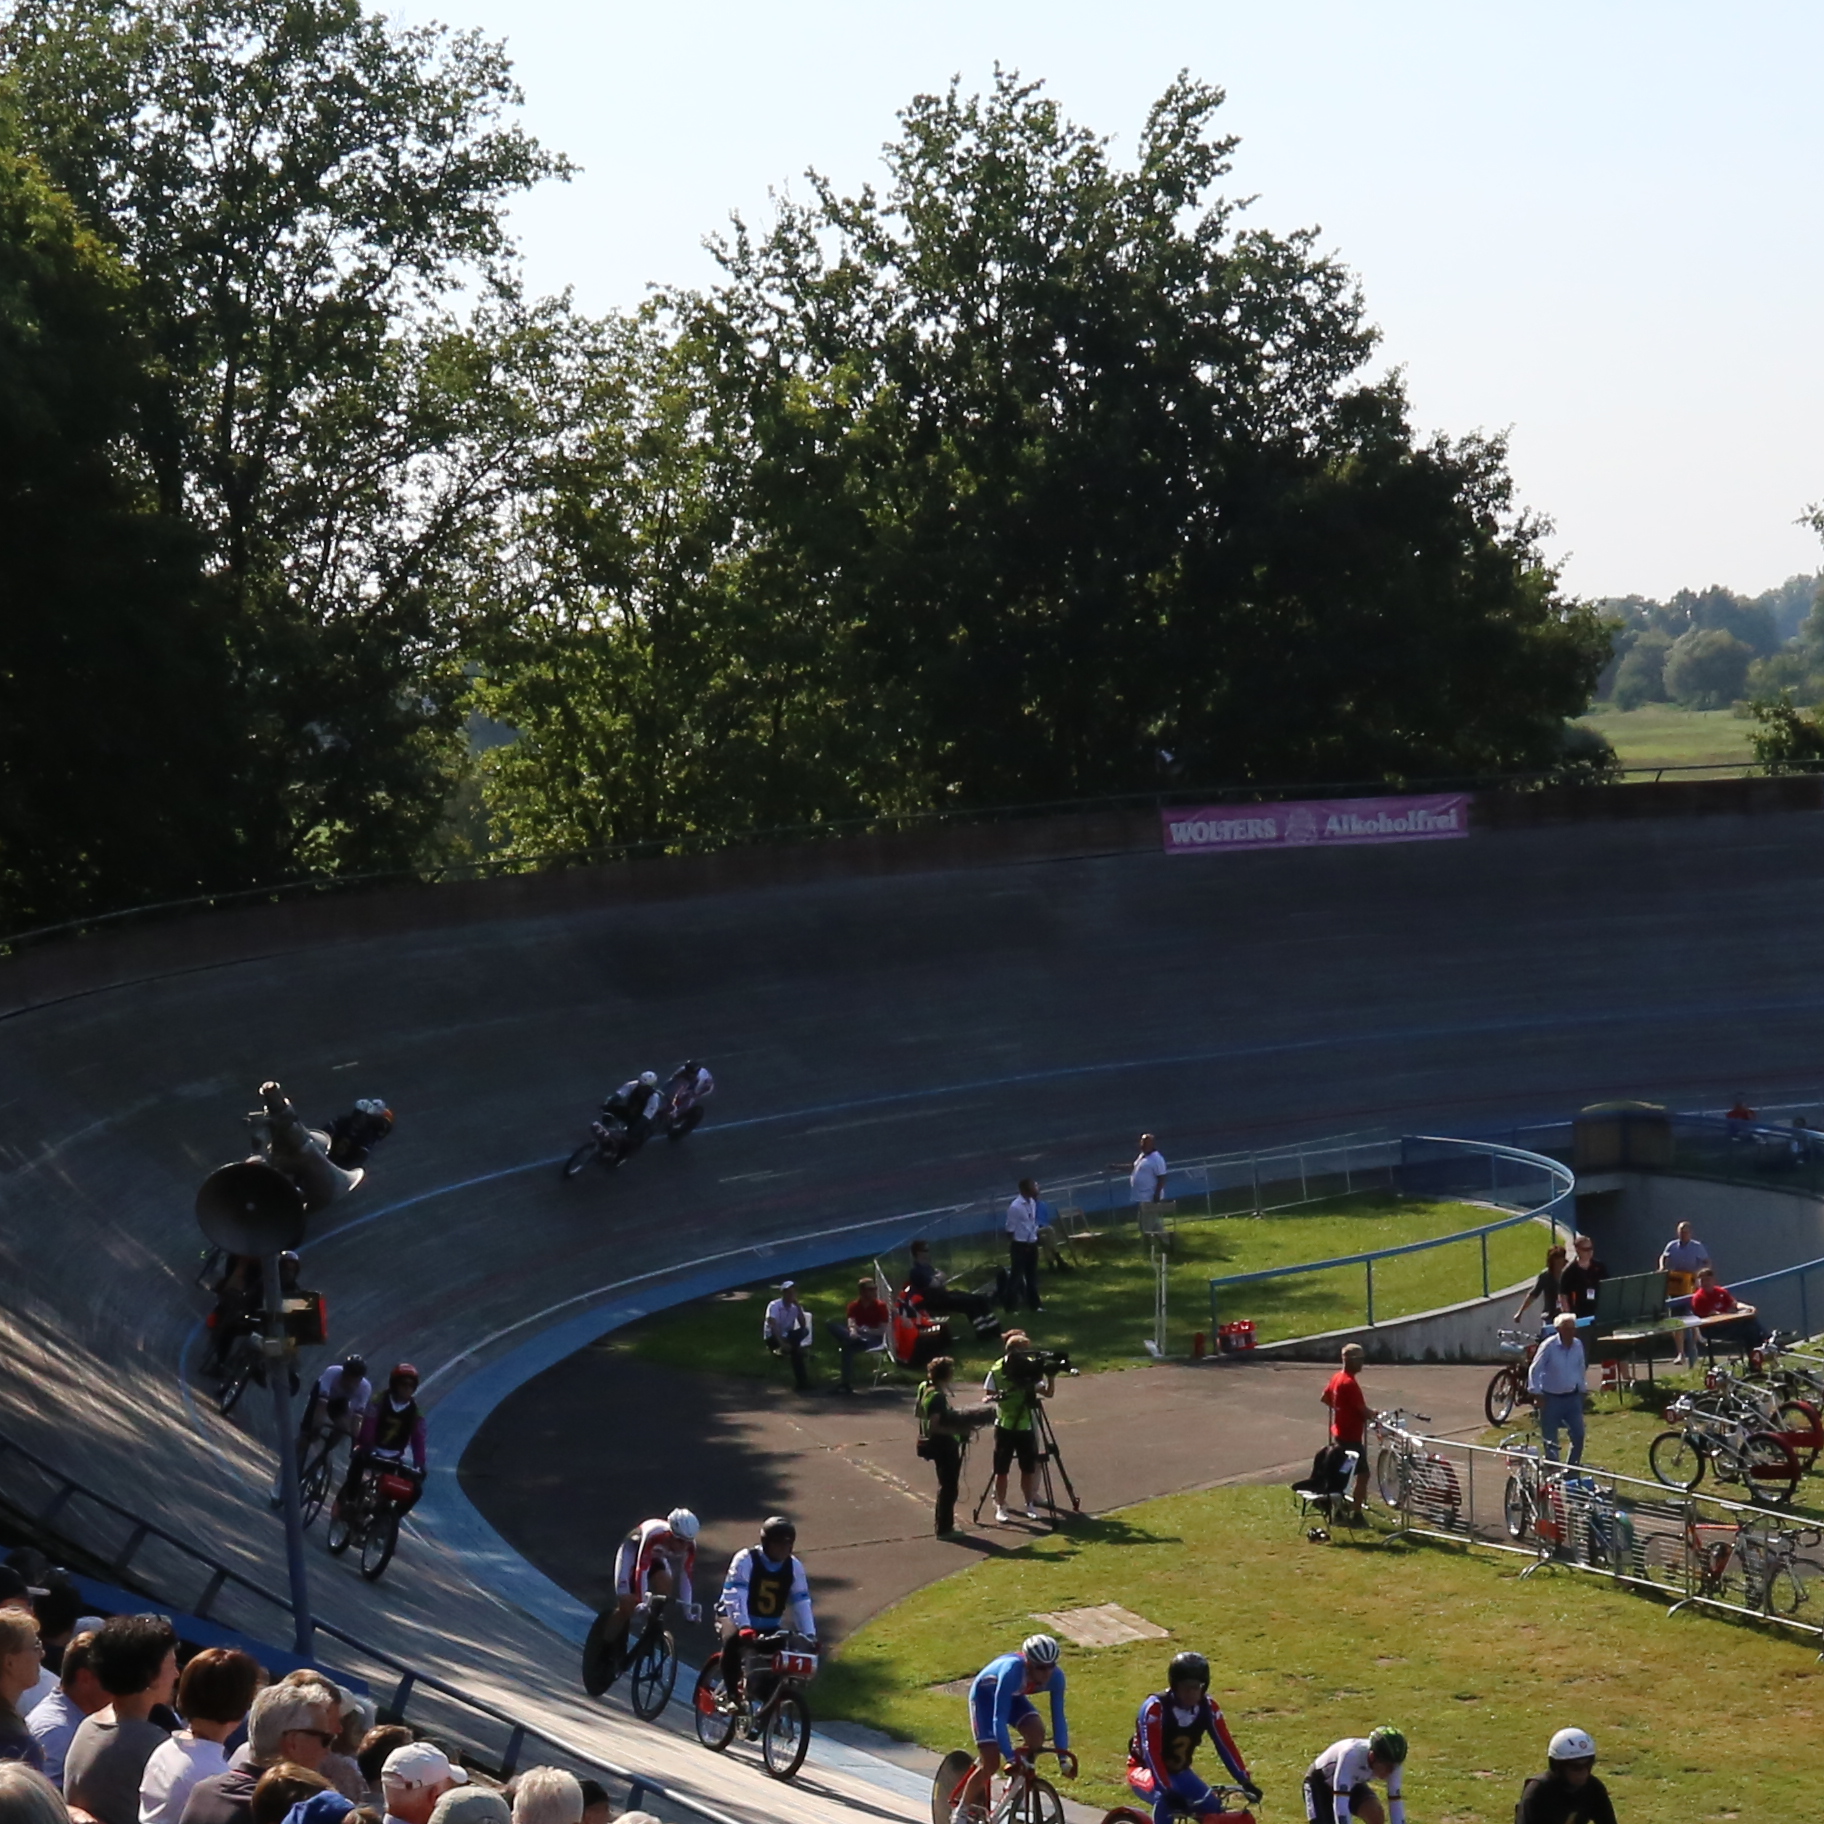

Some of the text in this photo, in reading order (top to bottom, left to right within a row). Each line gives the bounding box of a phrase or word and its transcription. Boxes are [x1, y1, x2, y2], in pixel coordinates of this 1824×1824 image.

[1170, 809, 1458, 844] WOLTERS Alkoholfrei
[756, 1580, 780, 1615] 5
[795, 1657, 804, 1671] 1
